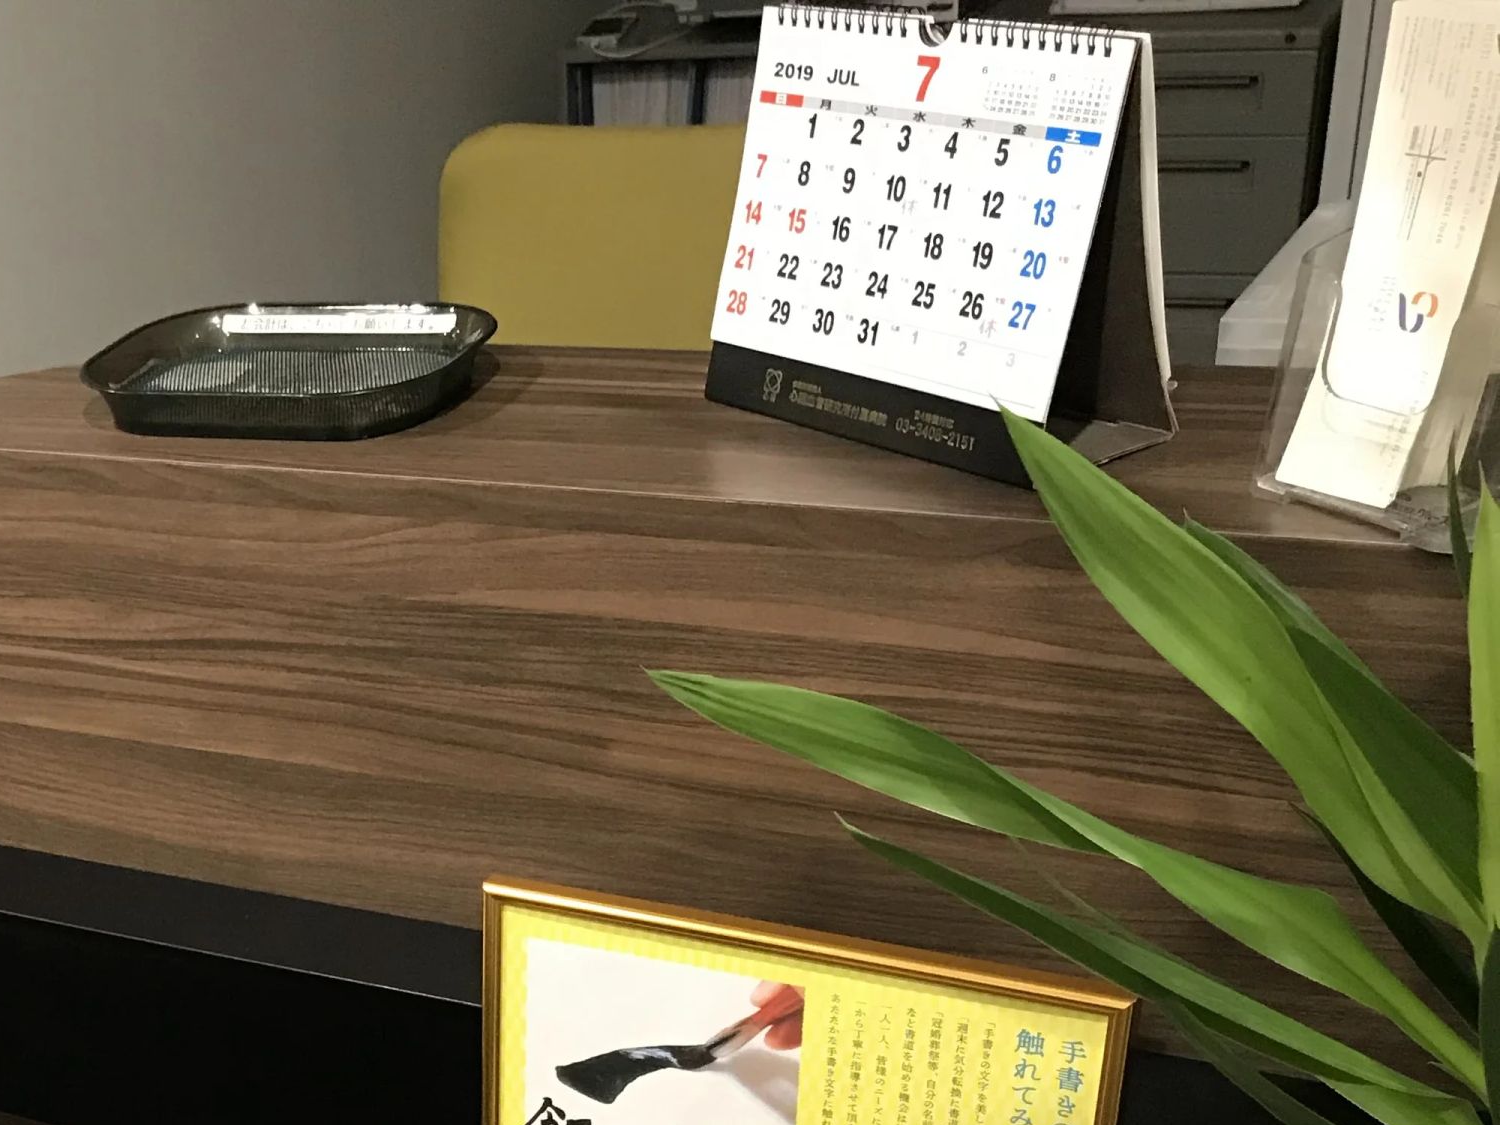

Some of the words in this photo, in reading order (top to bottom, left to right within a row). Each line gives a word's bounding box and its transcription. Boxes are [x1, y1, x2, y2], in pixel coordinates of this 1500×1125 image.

[774, 62, 814, 81] 2019
[826, 68, 860, 87] JUL
[915, 55, 941, 102] 7
[807, 113, 818, 139] 1
[850, 118, 865, 146] 2
[897, 124, 912, 152] 3
[944, 131, 959, 159] 4
[994, 138, 1011, 167] 5
[1047, 145, 1064, 174] 6
[819, 98, 833, 110] 月
[864, 104, 879, 117] 火
[912, 111, 928, 123] 水
[961, 117, 977, 129] 木
[1012, 123, 1028, 136] 金
[1064, 130, 1082, 144] 土
[755, 153, 768, 179] 7
[797, 160, 811, 187] 8
[842, 167, 856, 194] 9
[886, 175, 907, 202] 10
[933, 182, 952, 211] 11
[982, 190, 1005, 219] 12
[1033, 198, 1056, 228] 13
[745, 201, 762, 225] 14
[788, 208, 806, 234] 15
[832, 215, 851, 243] 16
[878, 223, 899, 251] 17
[923, 232, 944, 260] 18
[972, 241, 994, 270] 19
[1019, 250, 1047, 280] 20
[734, 245, 755, 271] 21
[776, 253, 800, 281] 22
[820, 262, 844, 290] 23
[865, 271, 889, 299] 24
[911, 280, 936, 310] 25
[958, 290, 985, 320] 26
[1008, 301, 1036, 330] 27
[726, 290, 747, 315] 28
[768, 298, 791, 326] 29
[812, 308, 835, 336] 30
[857, 318, 880, 346] 31
[911, 330, 920, 346] 1
[957, 341, 968, 357] 2
[1005, 352, 1016, 368] 3
